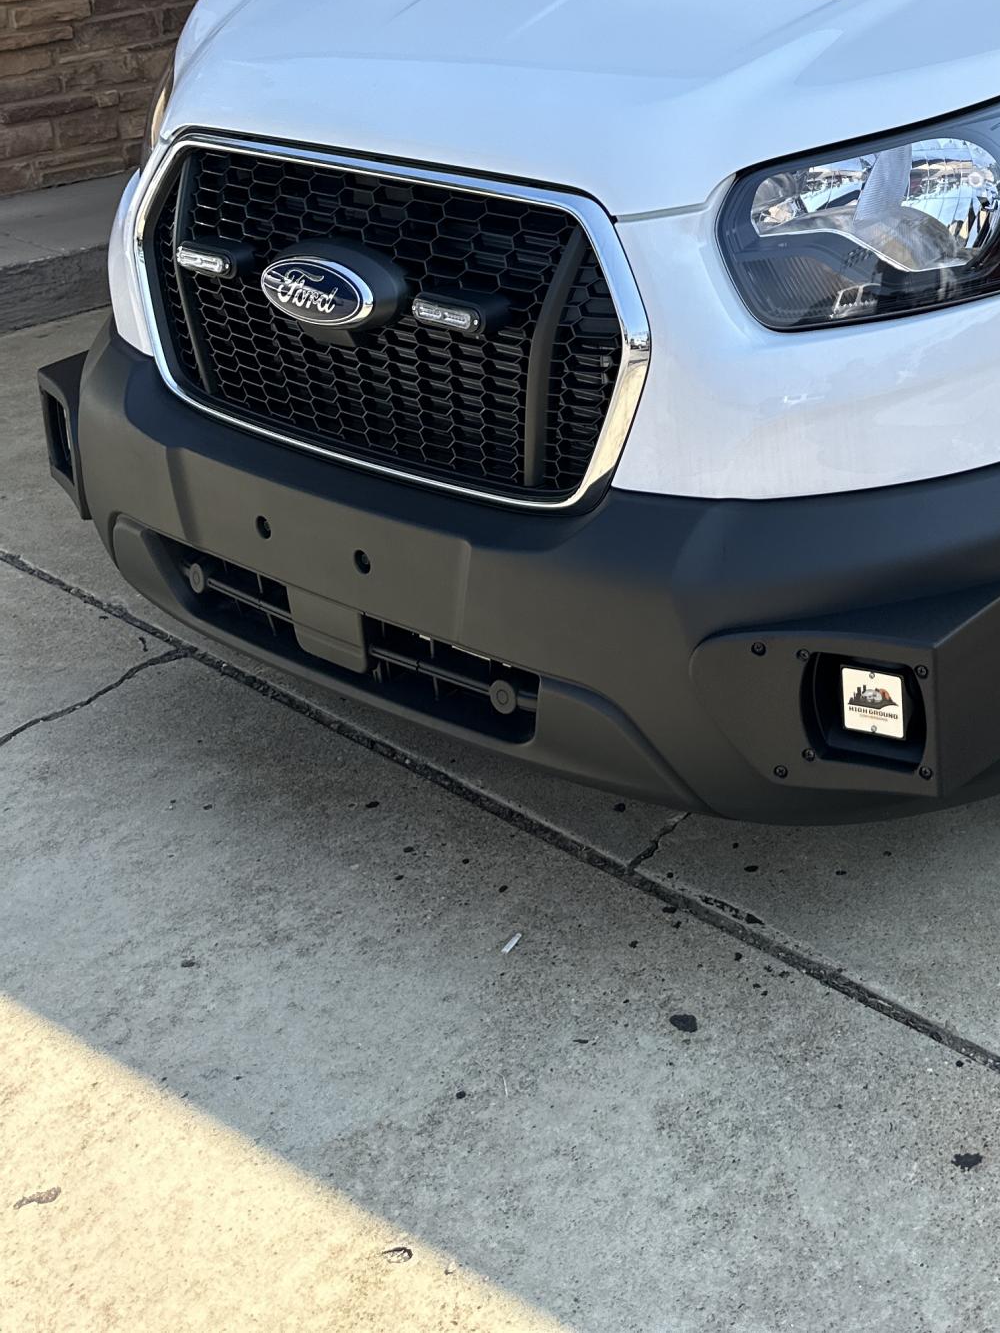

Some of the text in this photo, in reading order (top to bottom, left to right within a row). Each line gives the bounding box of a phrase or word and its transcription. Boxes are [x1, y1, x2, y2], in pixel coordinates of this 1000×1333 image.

[277, 269, 338, 314] Ford
[848, 706, 868, 714] HIGH
[868, 709, 898, 720] GROUND
